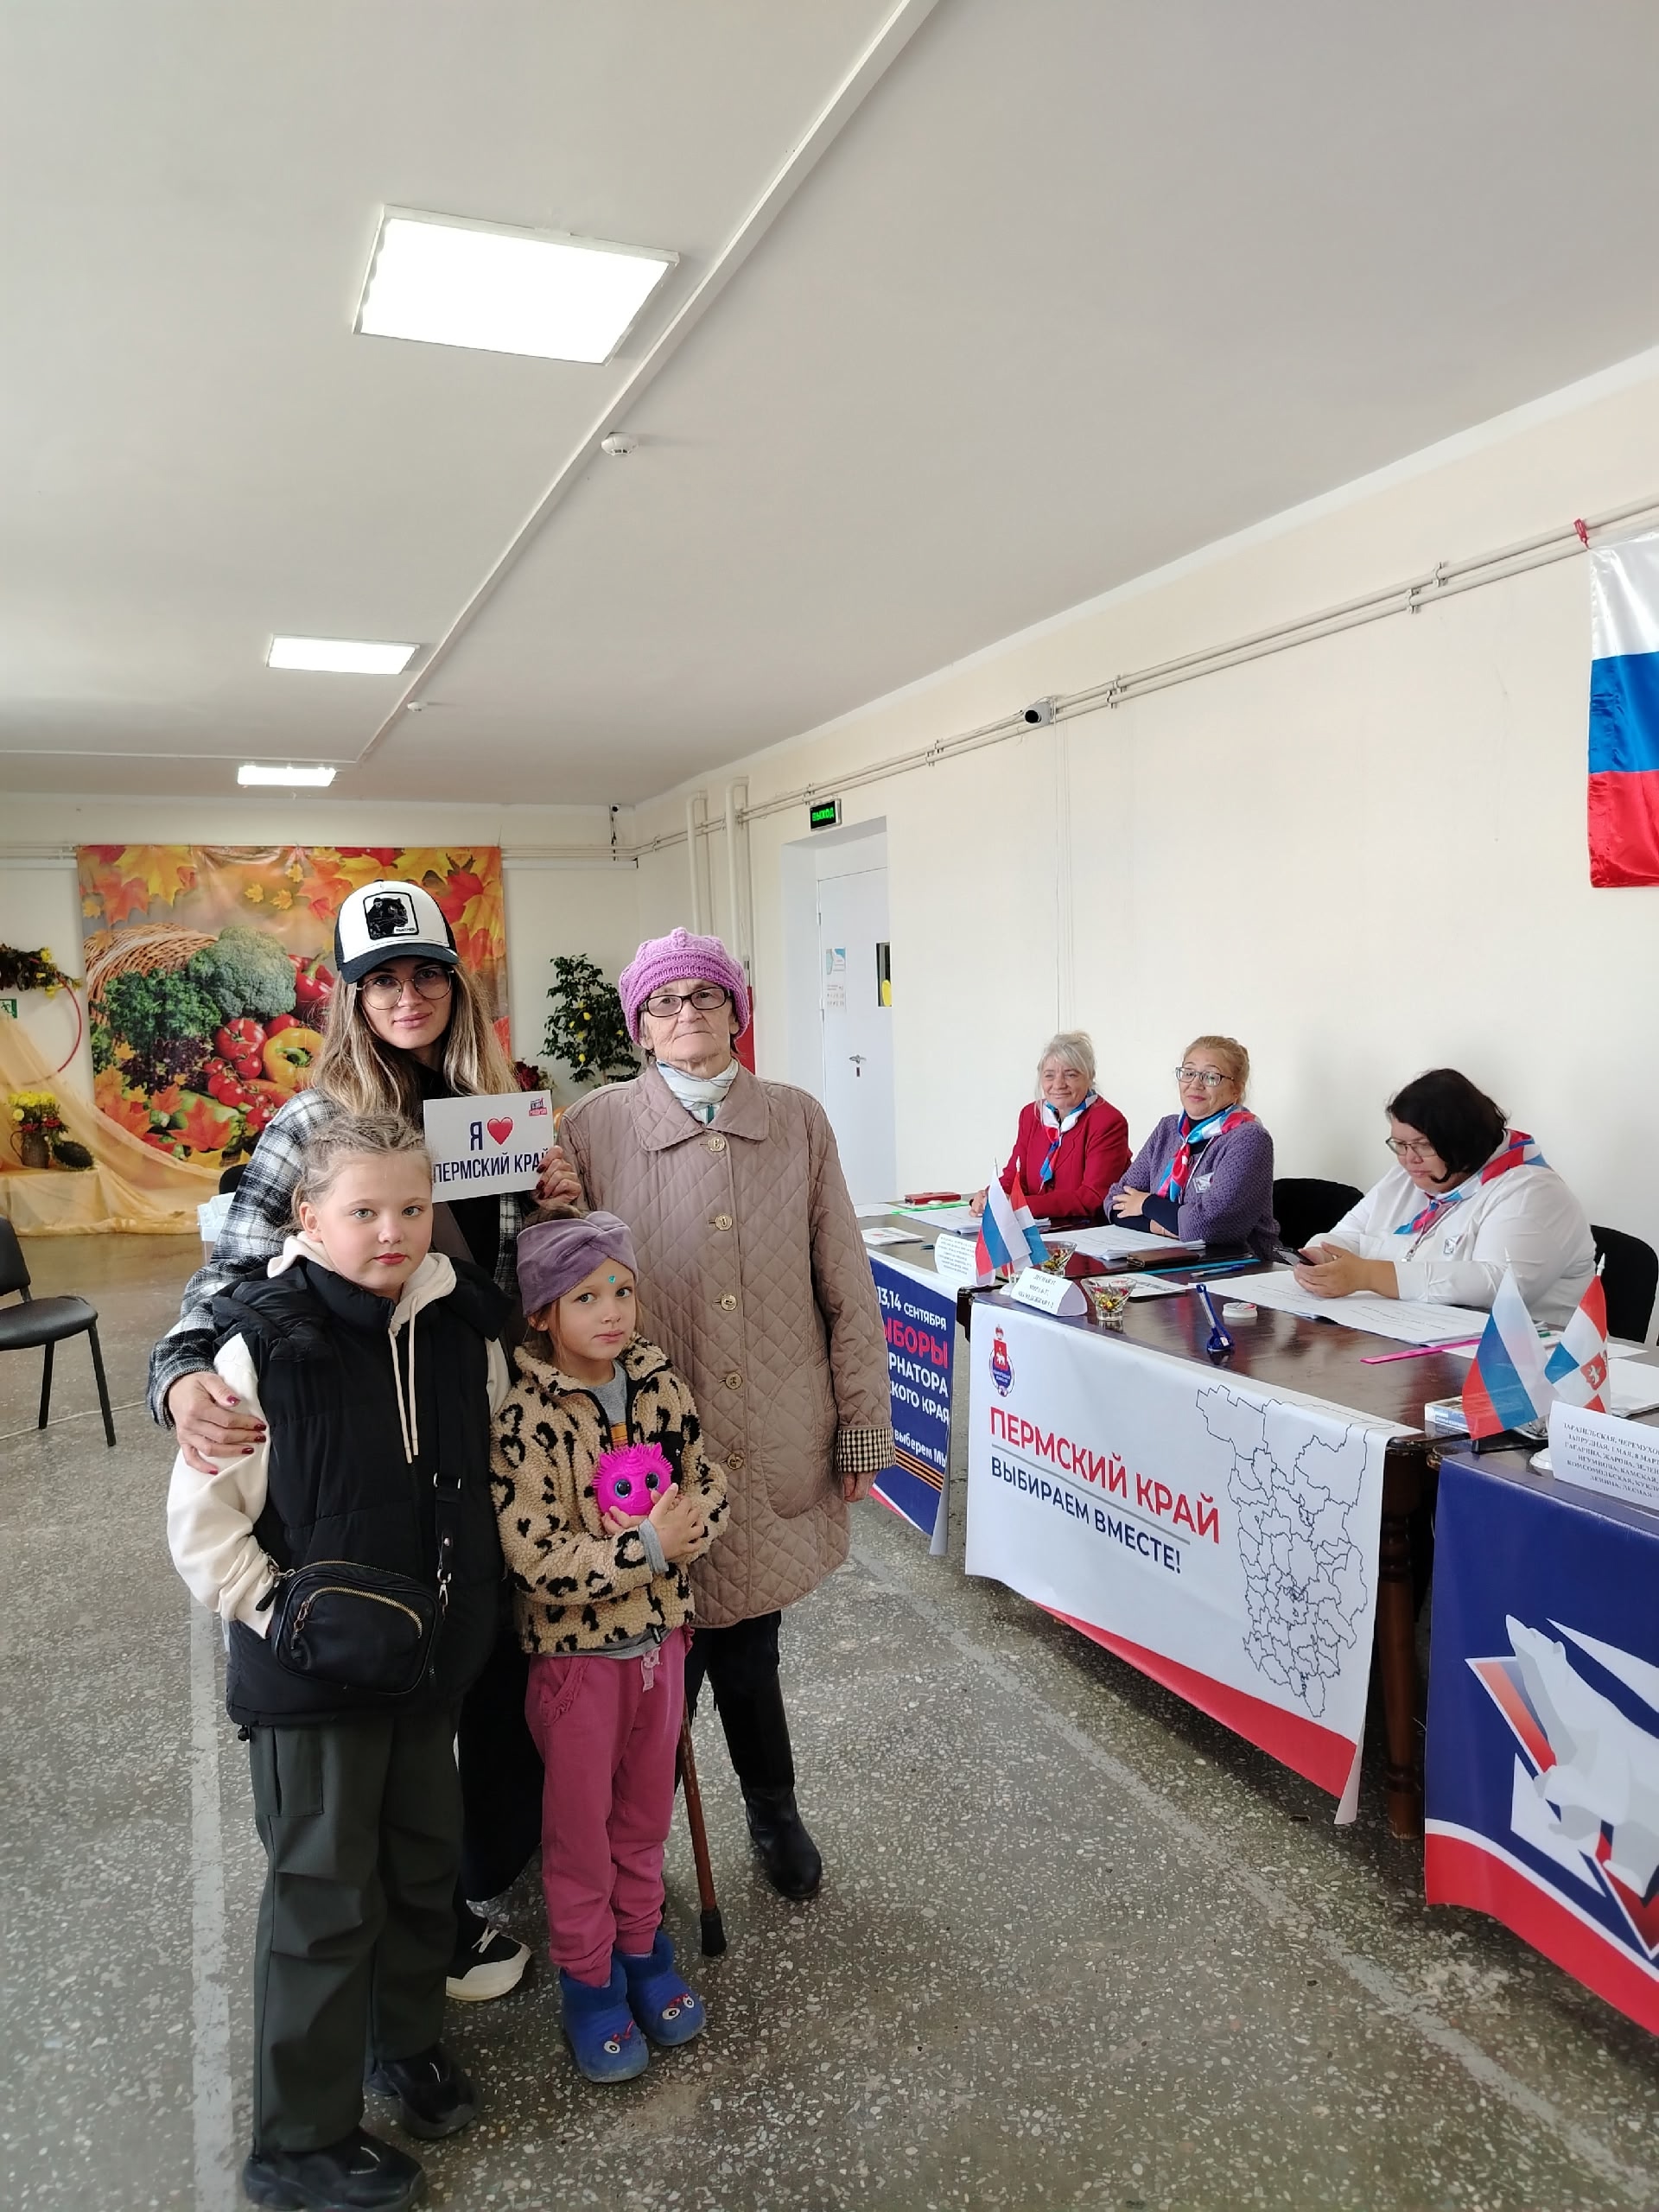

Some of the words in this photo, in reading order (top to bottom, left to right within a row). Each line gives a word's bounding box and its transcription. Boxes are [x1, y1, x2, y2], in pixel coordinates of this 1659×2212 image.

[812, 807, 834, 821] ВЫХОД
[470, 1121, 483, 1151] Я
[434, 1152, 510, 1183] ПЕРМСКИЙ
[904, 1302, 947, 1331] СЕНТЯБРЯ
[884, 1317, 948, 1369] ЫБОРЫ
[889, 1351, 949, 1398] РНАТОРА
[890, 1381, 919, 1408] КОГО
[922, 1395, 950, 1425] КРАЯ
[893, 1429, 932, 1459] выберем
[990, 1406, 1127, 1499] ПЕРМСКИЙ
[1136, 1471, 1219, 1544] КРАЙ
[992, 1456, 1090, 1525] ВЫБИРАЕМ
[1094, 1508, 1181, 1574] ВМЕСТЕ!
